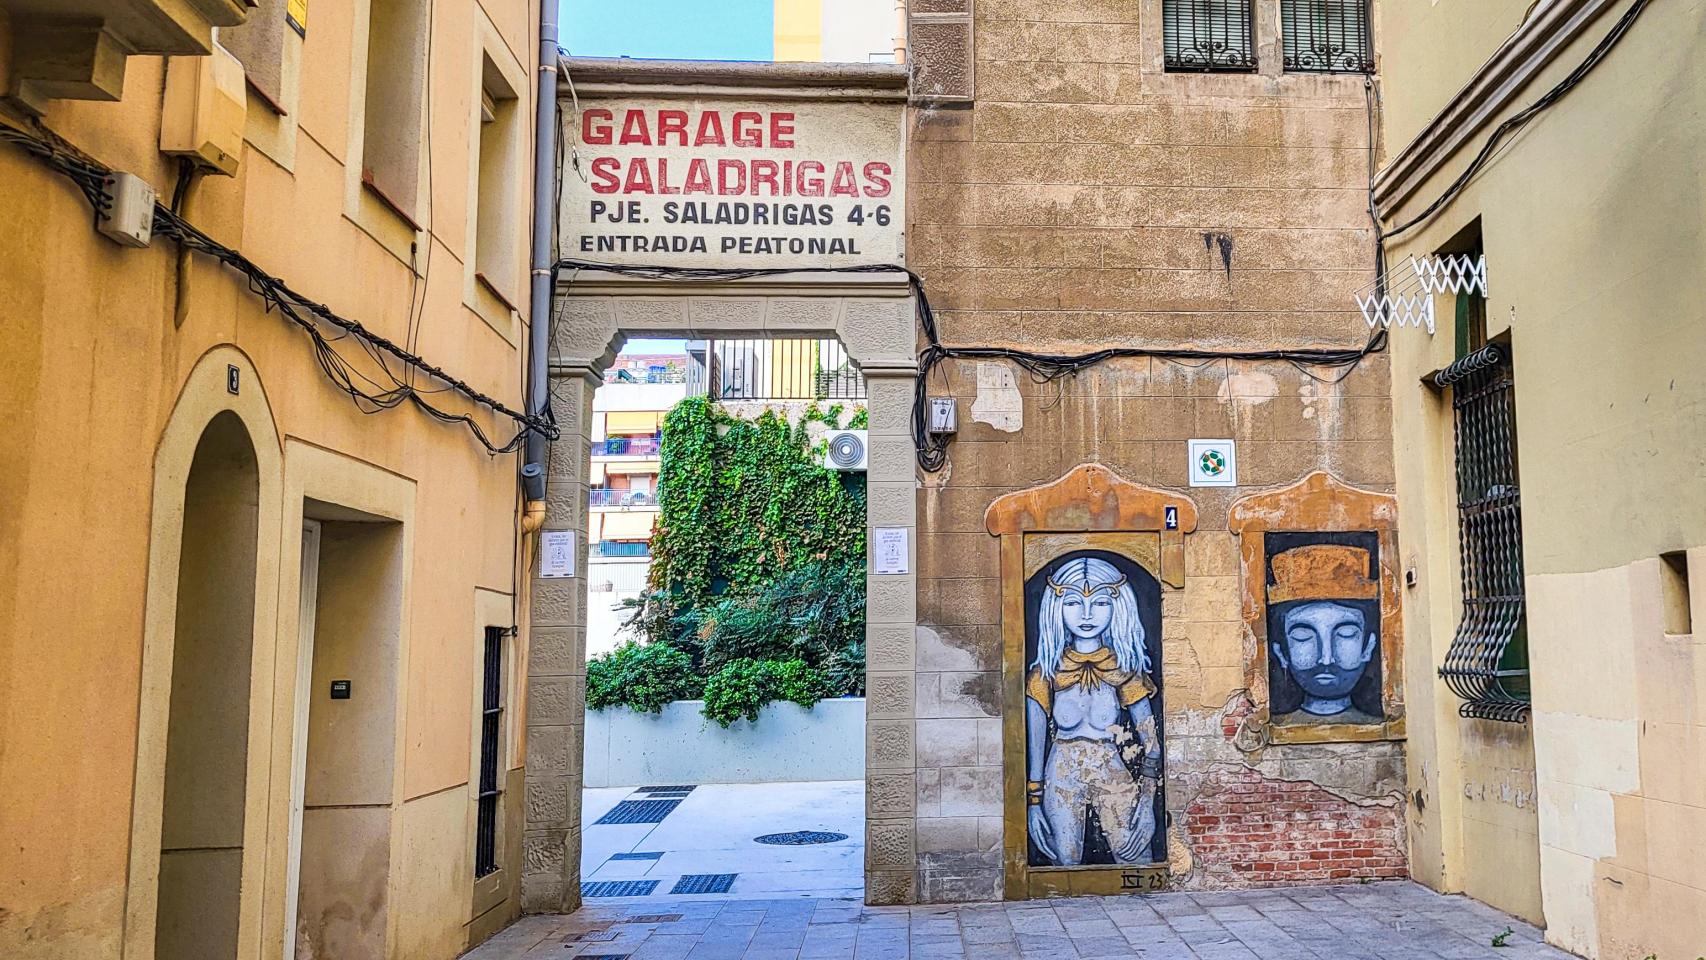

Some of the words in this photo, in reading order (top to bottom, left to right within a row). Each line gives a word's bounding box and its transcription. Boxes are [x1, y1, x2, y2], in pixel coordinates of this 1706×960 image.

[581, 108, 796, 149] GARAGE
[590, 157, 893, 198] SALADRIGAS
[590, 200, 650, 224] PJE.
[663, 201, 834, 226] SALADRIGAS
[580, 235, 708, 254] ENTRADA
[720, 236, 862, 255] PEATONAL
[1166, 509, 1176, 527] 4
